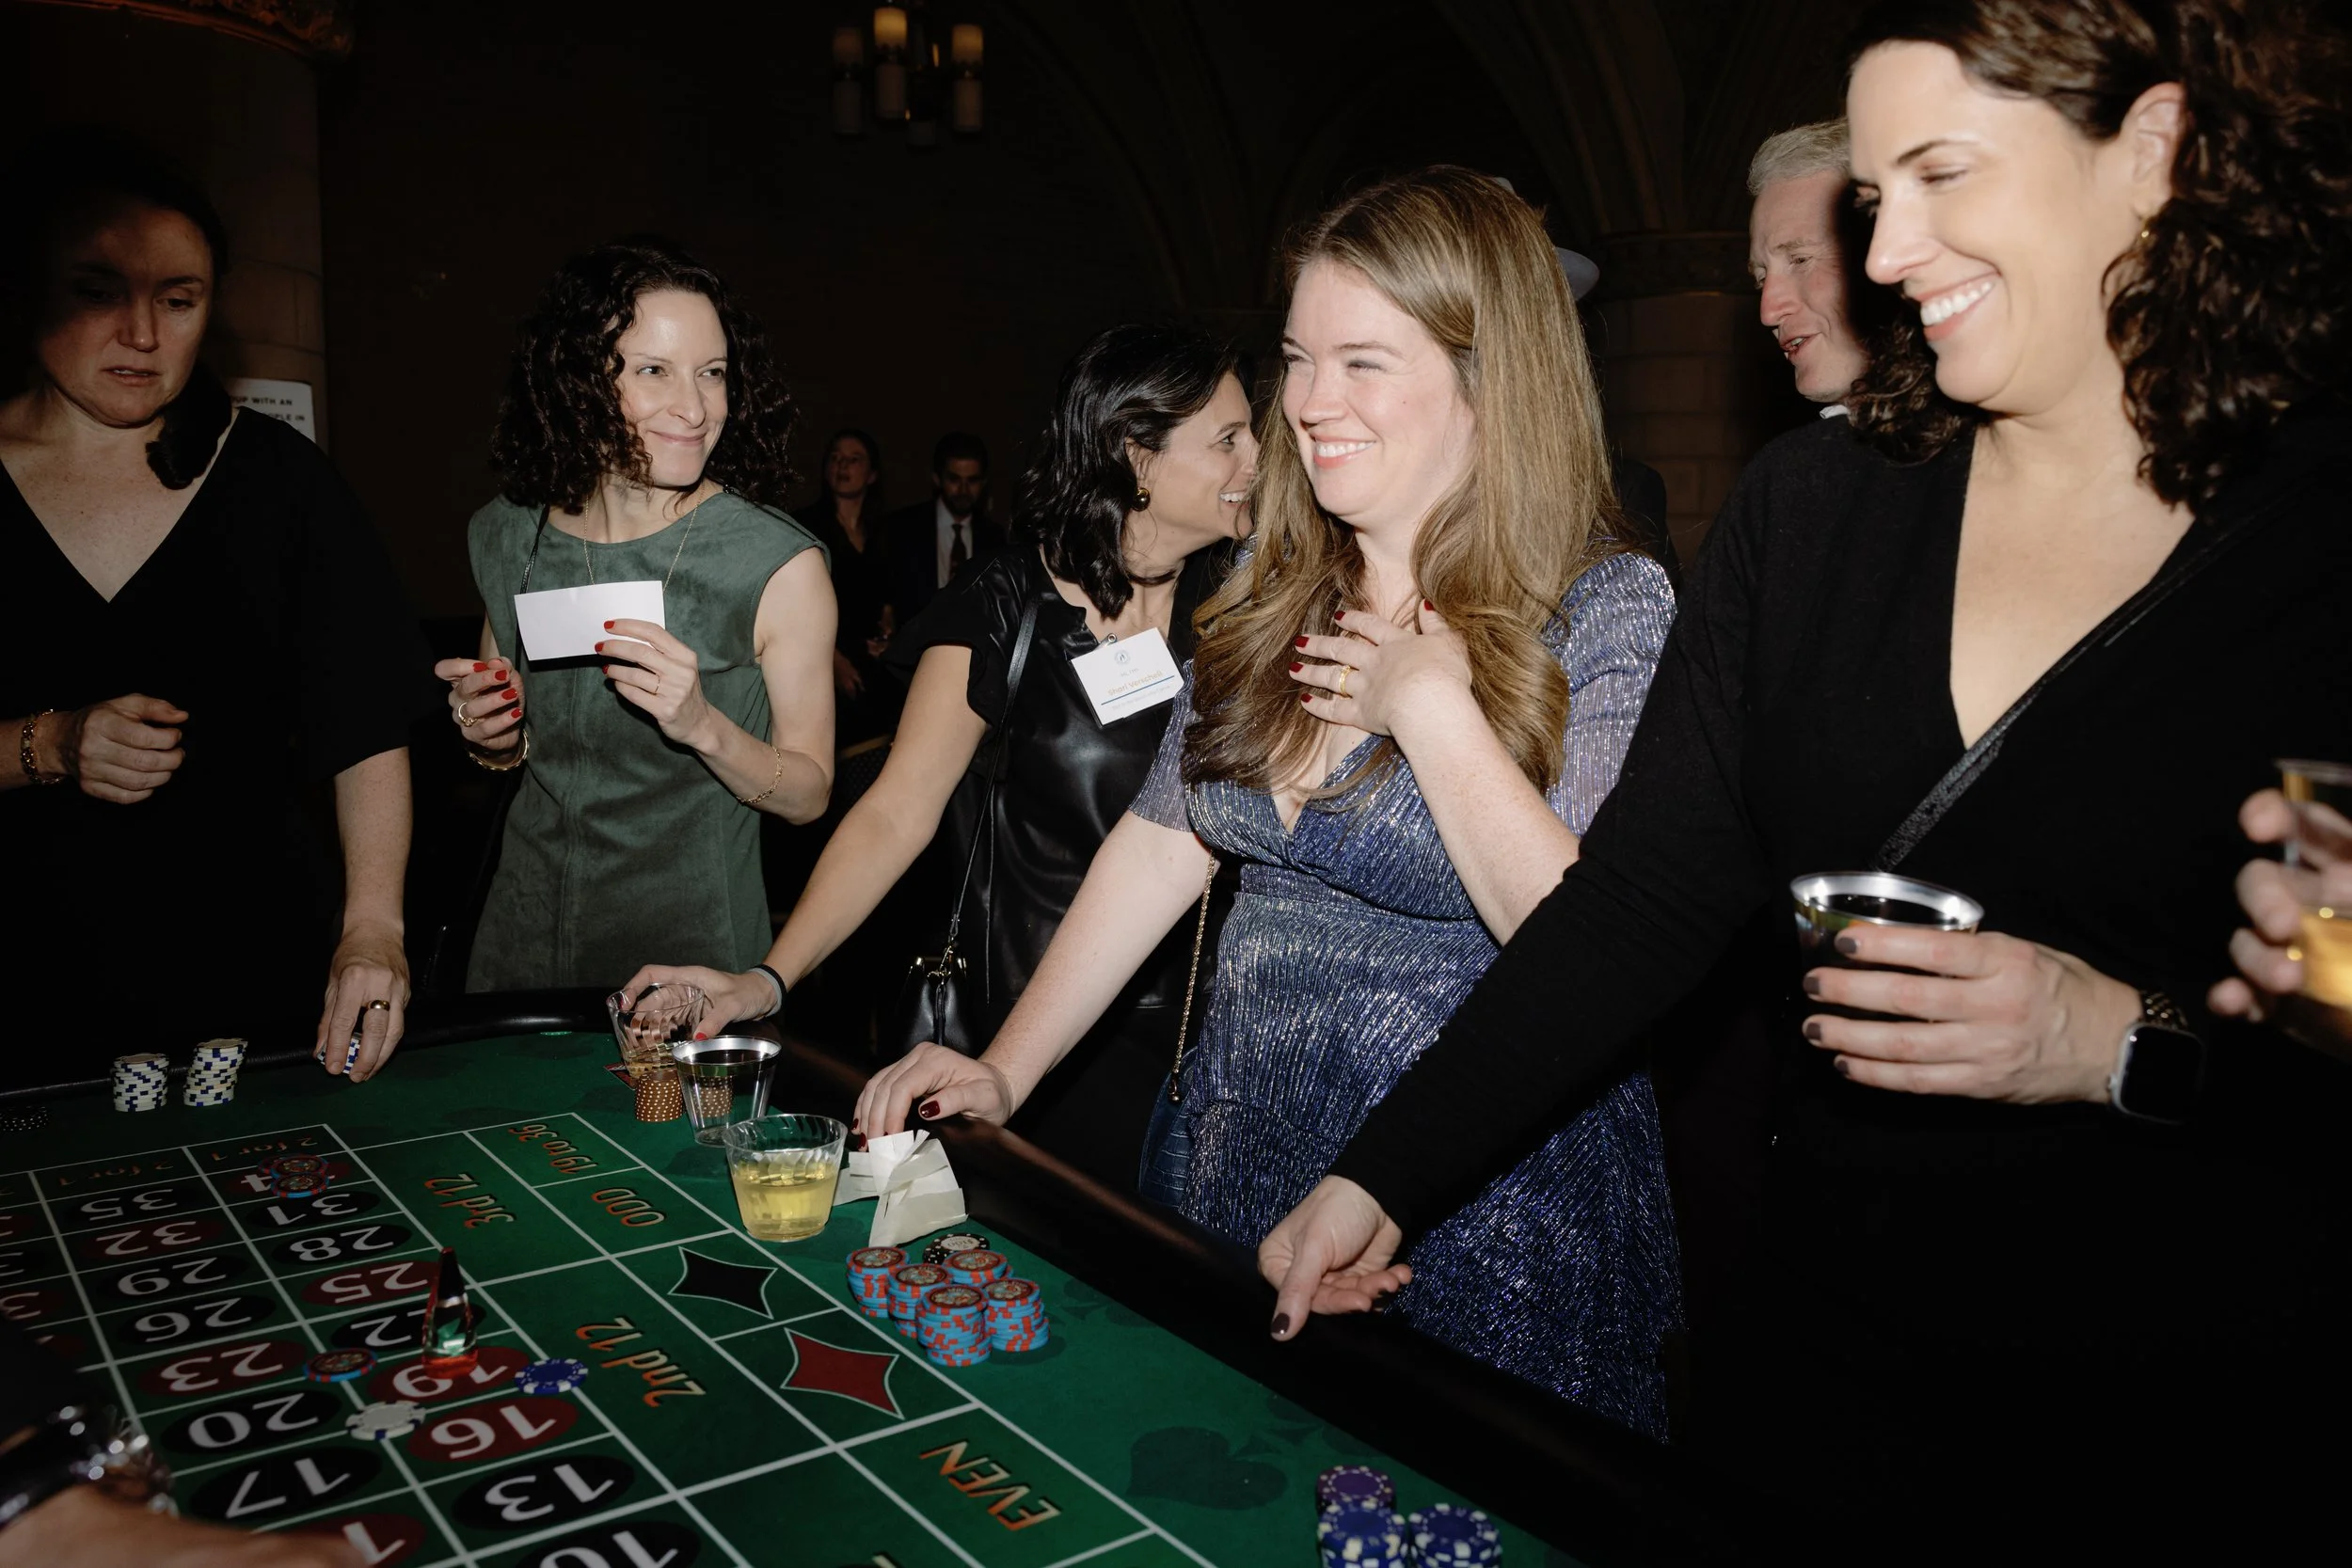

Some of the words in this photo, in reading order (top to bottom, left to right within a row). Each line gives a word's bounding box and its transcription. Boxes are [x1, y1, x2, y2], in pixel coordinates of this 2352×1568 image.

[508, 1123, 559, 1142] 36
[80, 1188, 179, 1221] 35
[424, 1173, 479, 1196] 12
[266, 1193, 359, 1226] 31
[438, 1193, 516, 1229] 3rd
[590, 1187, 666, 1227] ODD
[95, 1221, 202, 1256] 32
[289, 1226, 395, 1262] 28
[117, 1257, 228, 1296] 29
[320, 1261, 428, 1304] 25
[135, 1297, 252, 1342] 26
[575, 1317, 643, 1352] 12
[160, 1342, 284, 1392] 23
[600, 1348, 707, 1407] 2nd
[188, 1392, 320, 1449] 20
[430, 1404, 557, 1460] 16
[225, 1457, 351, 1519] 17
[485, 1464, 614, 1522] 13
[918, 1438, 1062, 1532] EVEN
